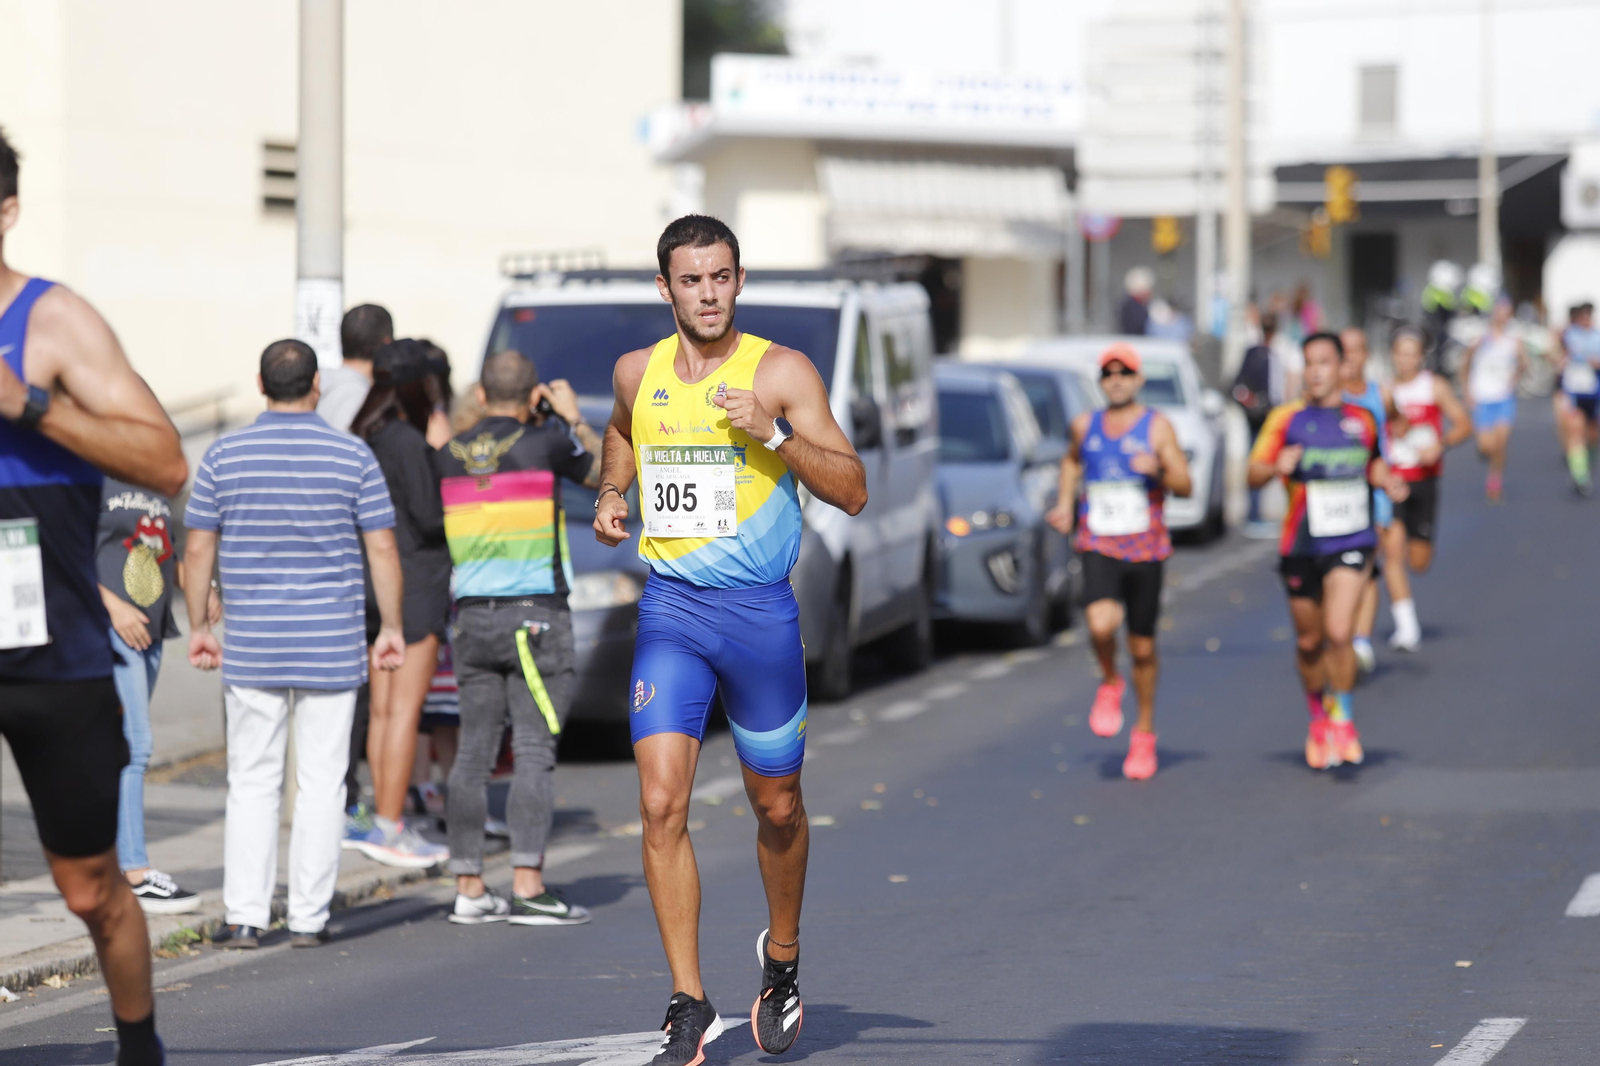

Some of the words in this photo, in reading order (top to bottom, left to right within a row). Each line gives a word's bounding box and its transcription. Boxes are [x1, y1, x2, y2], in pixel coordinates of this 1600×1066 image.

[653, 450, 682, 462] VUELTA
[684, 450, 691, 462] A
[693, 450, 727, 462] HUELVA
[654, 482, 698, 512] 305
